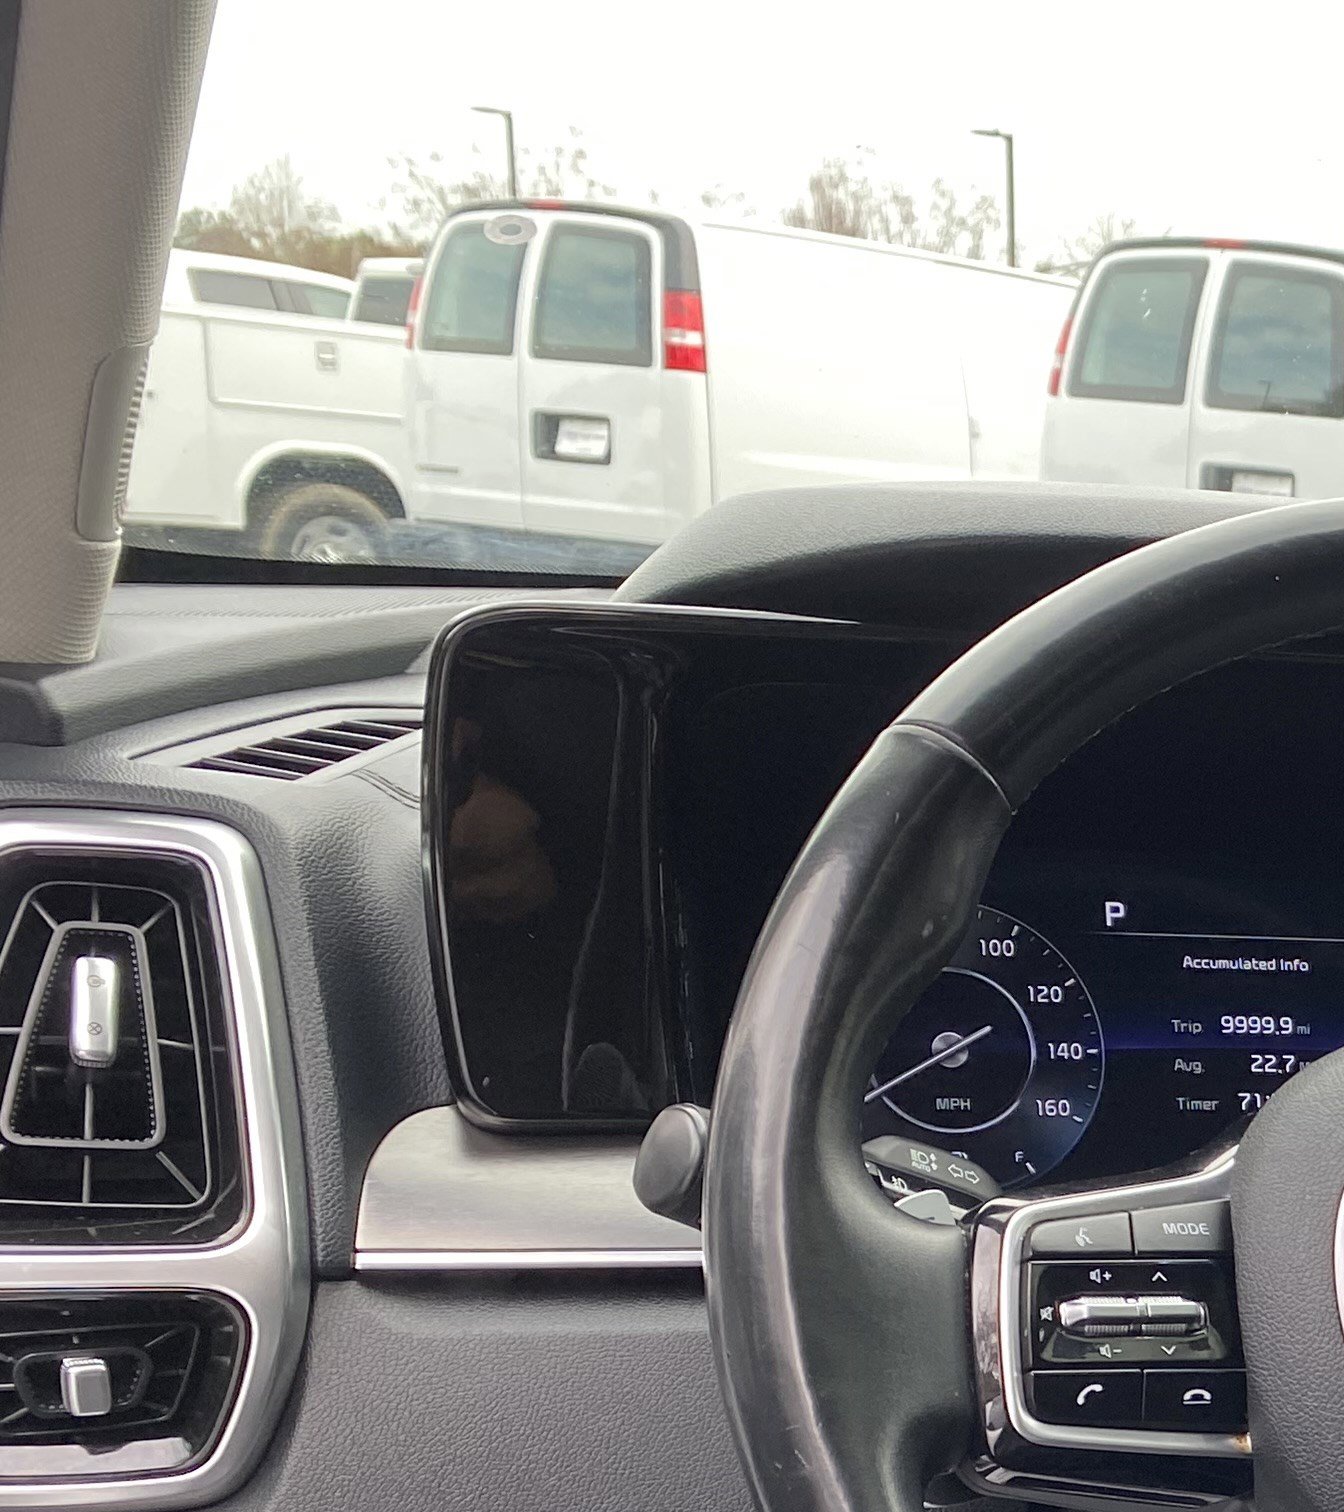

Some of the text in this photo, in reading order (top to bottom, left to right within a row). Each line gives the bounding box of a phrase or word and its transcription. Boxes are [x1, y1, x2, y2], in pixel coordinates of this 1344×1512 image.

[1104, 901, 1125, 927] P
[978, 938, 1015, 957] 100
[1182, 955, 1310, 972] Accumulated Info
[1027, 985, 1063, 1004] 120
[1171, 1015, 1312, 1036] Trip 9999.9 mi
[1047, 1042, 1083, 1060] 140
[1173, 1058, 1206, 1074] Avg.
[1250, 1054, 1295, 1074] 22.7
[935, 1098, 971, 1111] MPH
[1035, 1098, 1071, 1117] 160
[1176, 1096, 1220, 1111] Timer
[1162, 1222, 1211, 1236] MODE
